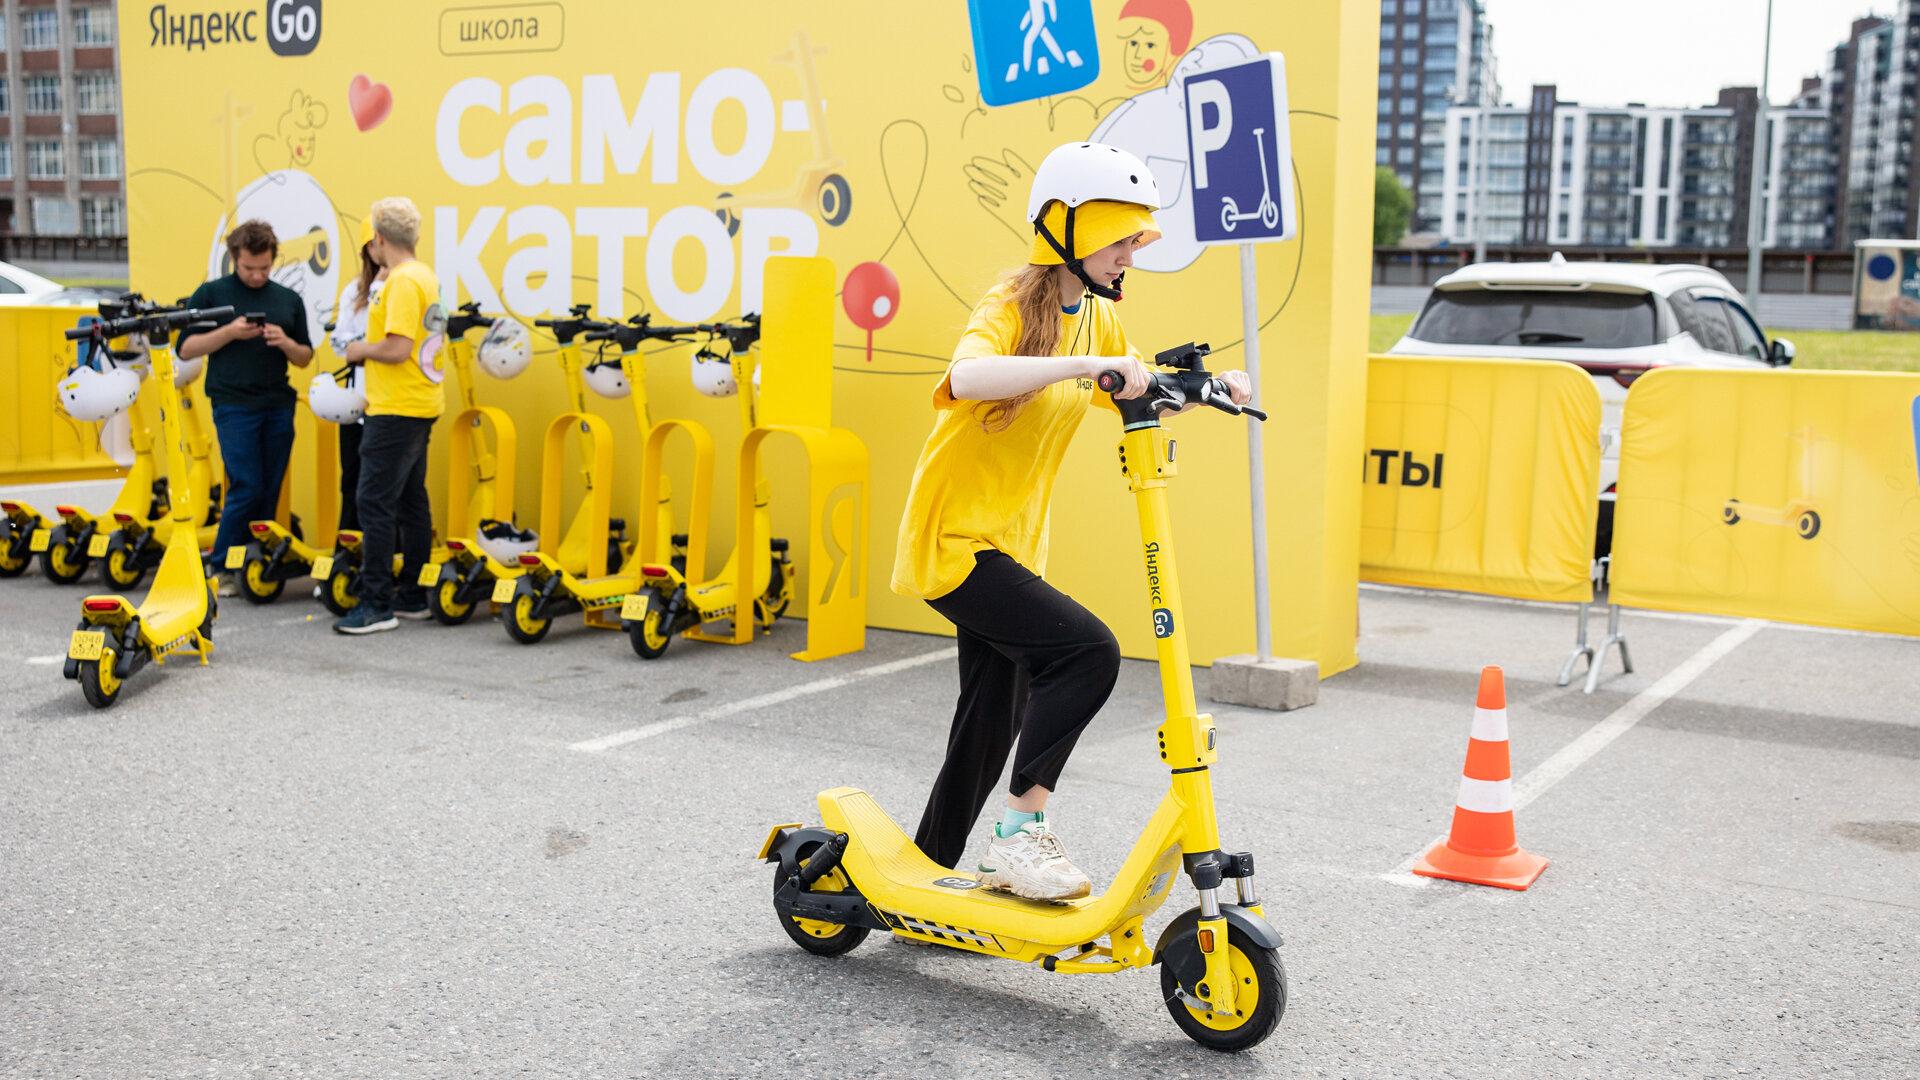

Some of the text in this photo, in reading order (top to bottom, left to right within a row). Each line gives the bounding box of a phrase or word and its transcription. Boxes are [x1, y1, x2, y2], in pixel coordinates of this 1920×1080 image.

[149, 0, 317, 51] Яндекс Go
[459, 14, 539, 42] школа
[435, 67, 827, 186] само-
[1187, 79, 1233, 189] P
[819, 480, 864, 606] Я
[1145, 541, 1168, 636] Яндекс Go
